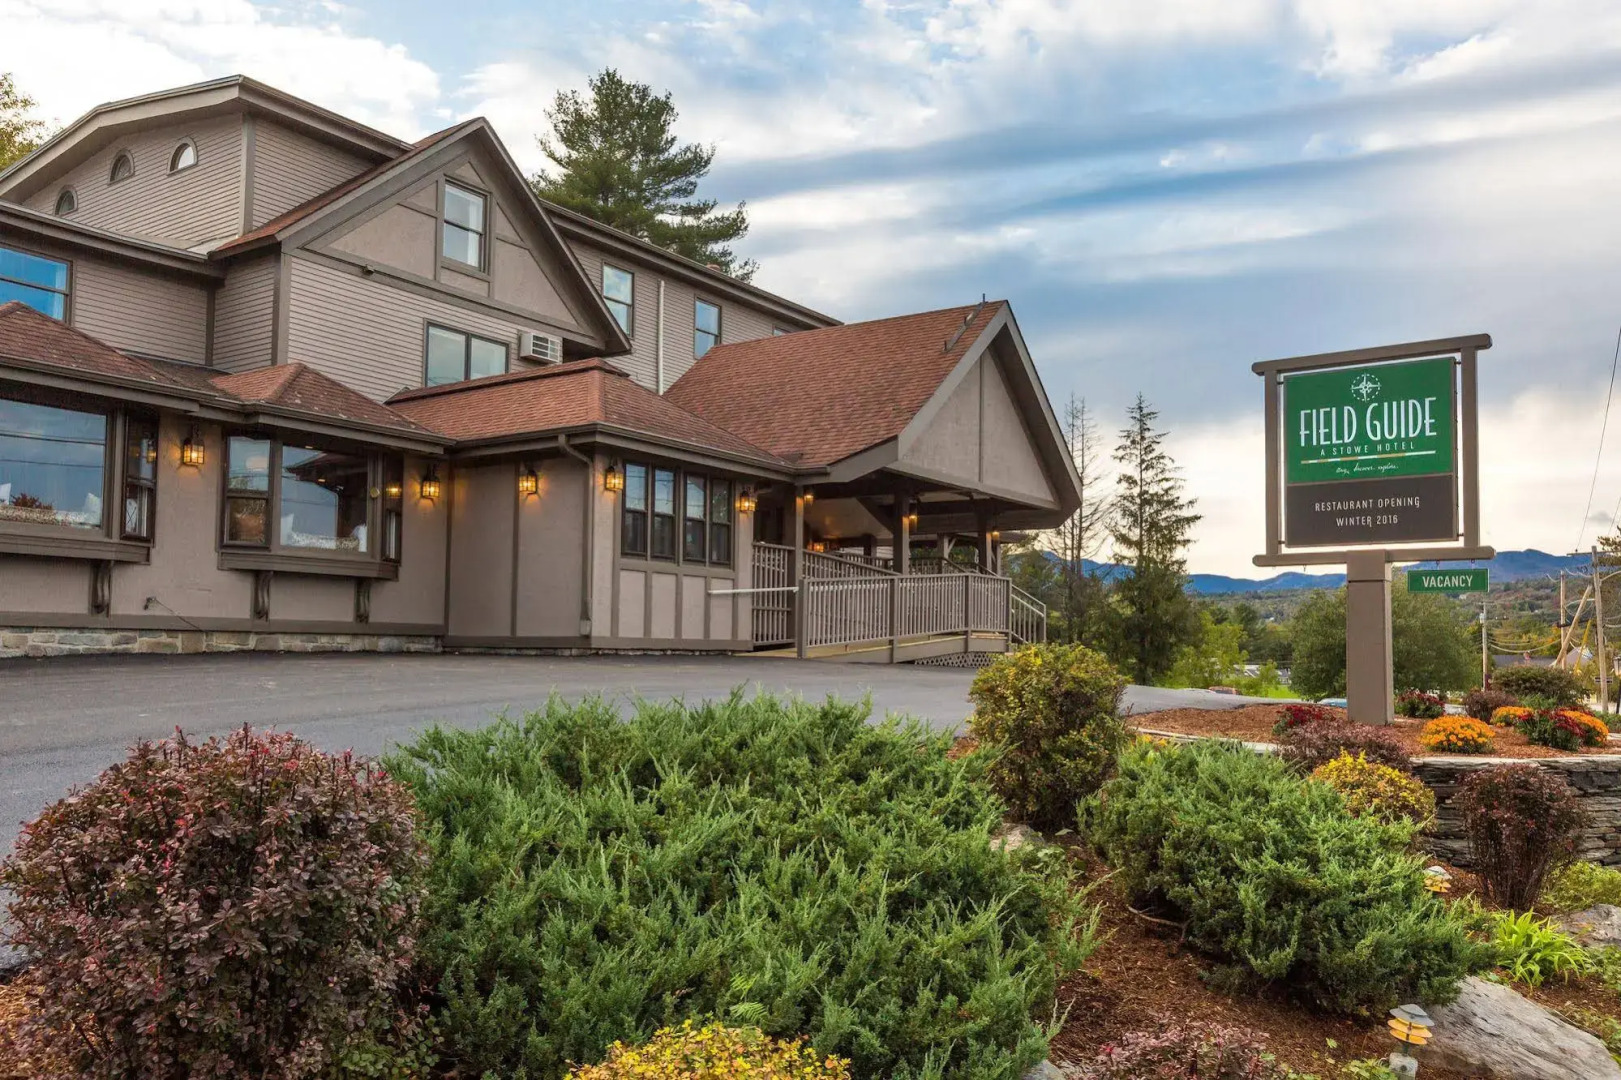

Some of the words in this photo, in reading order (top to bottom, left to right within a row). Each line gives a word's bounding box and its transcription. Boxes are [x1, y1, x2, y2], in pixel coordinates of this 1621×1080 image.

[1299, 405, 1357, 447] FIELD
[1365, 397, 1437, 441] GUIDE
[1332, 444, 1369, 456] STOWE
[1377, 441, 1415, 452] HOTEL
[1314, 499, 1374, 512] RESTAURANT
[1377, 496, 1420, 508] OPENING
[1336, 515, 1372, 527] WINTER
[1376, 514, 1399, 525] 2016
[1422, 574, 1473, 588] VACANCY
